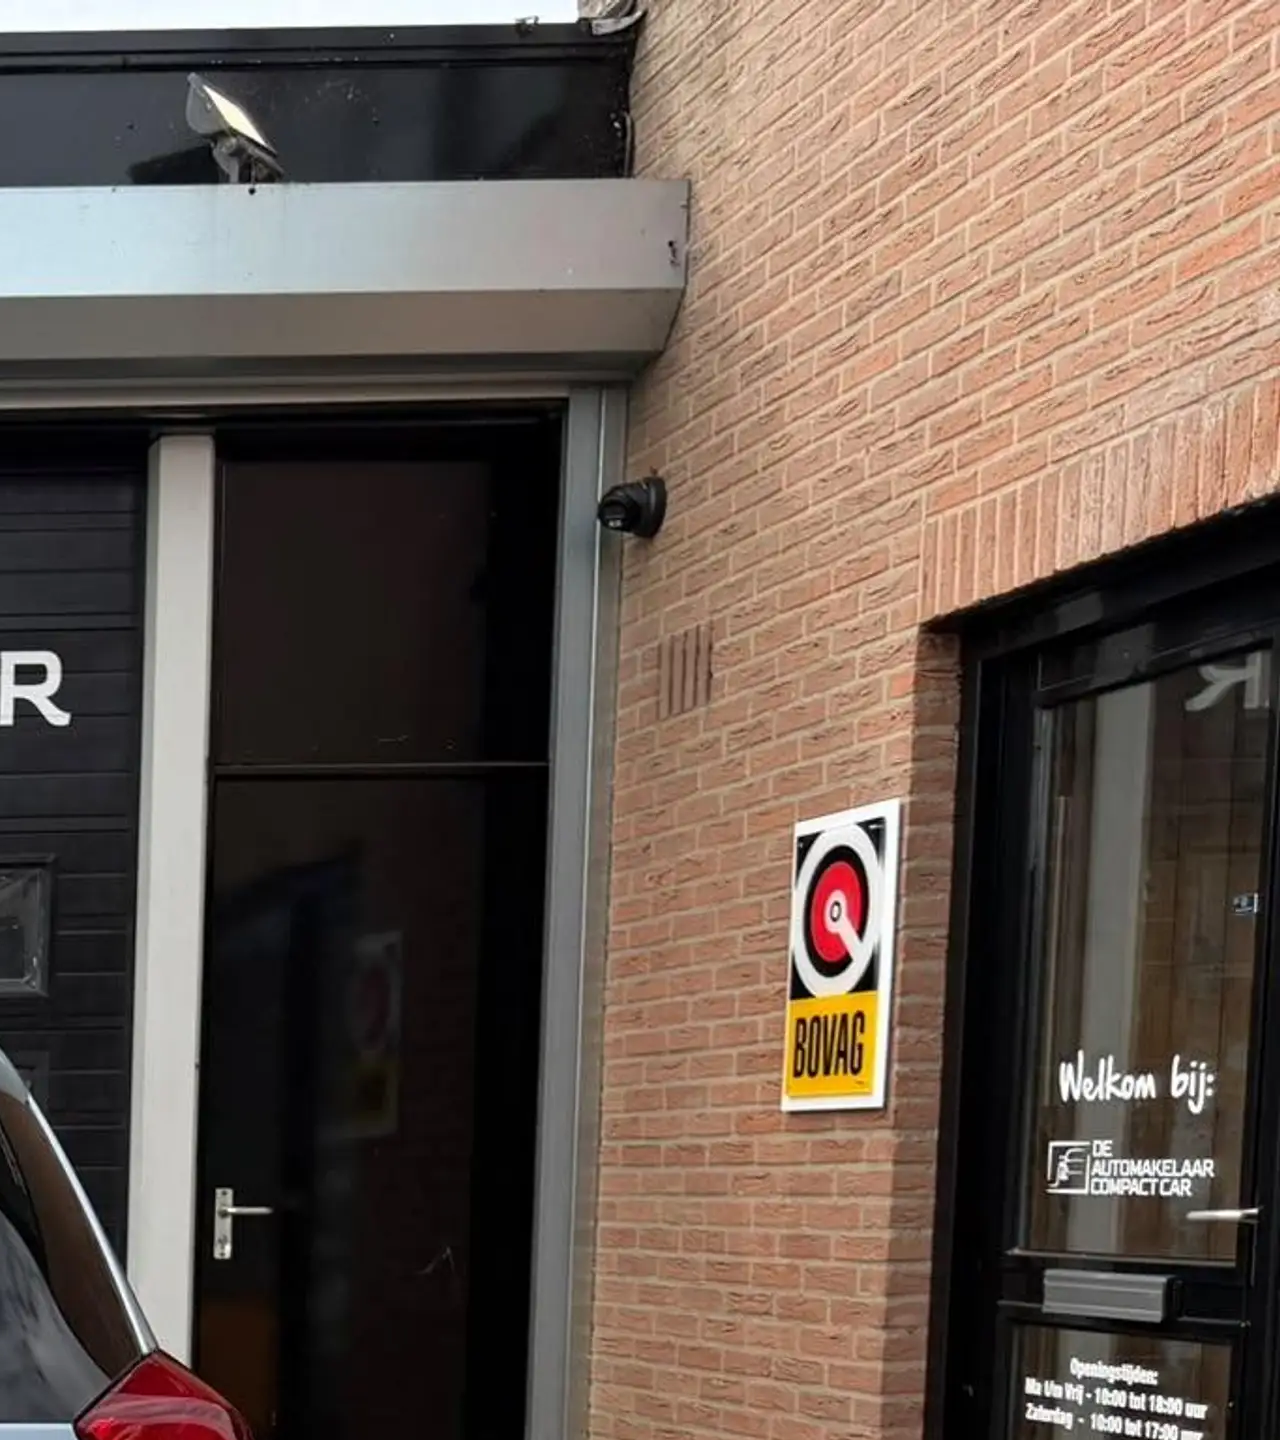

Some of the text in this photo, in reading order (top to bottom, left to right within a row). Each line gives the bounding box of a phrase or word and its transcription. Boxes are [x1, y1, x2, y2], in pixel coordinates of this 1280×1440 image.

[793, 1010, 865, 1079] BOVAG
[1059, 1050, 1215, 1114] Welkom bij:
[1092, 1140, 1113, 1157] DE
[1091, 1158, 1215, 1178] AUTOMAKELAAR
[1090, 1178, 1193, 1197] COMPACT CAR
